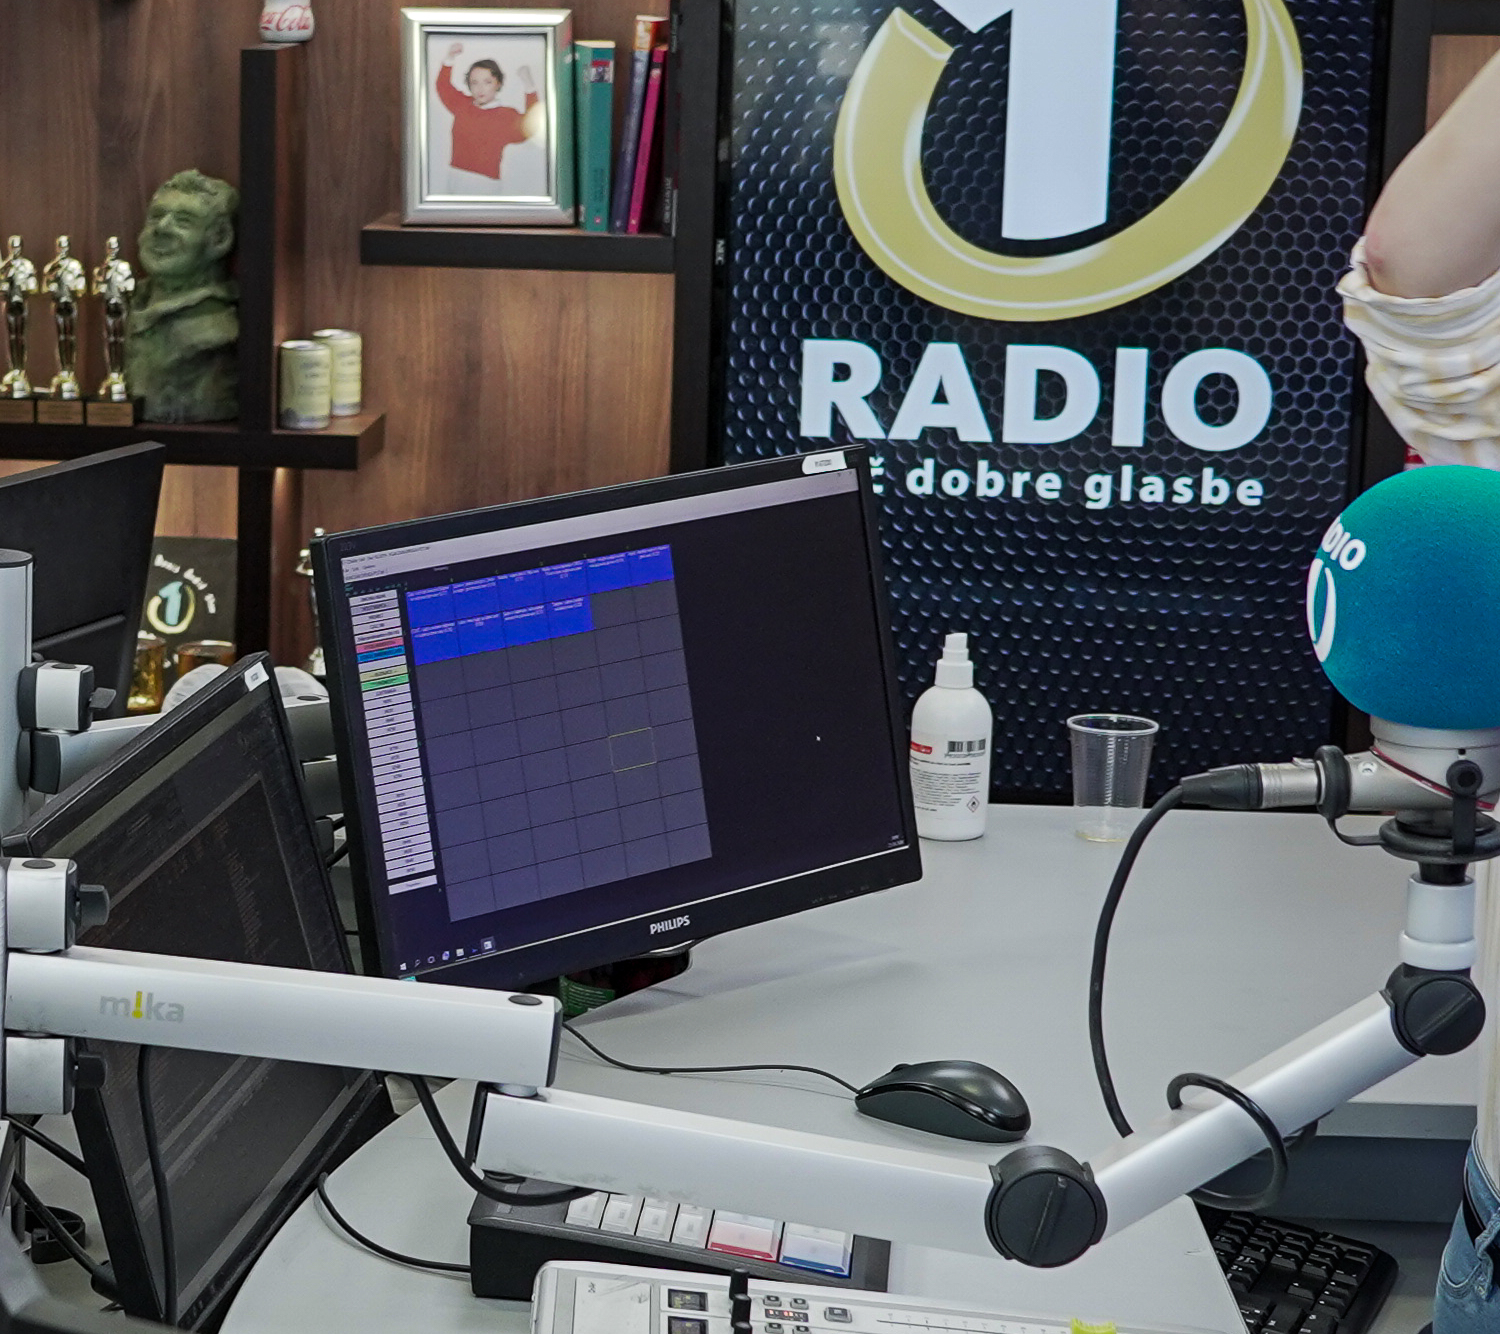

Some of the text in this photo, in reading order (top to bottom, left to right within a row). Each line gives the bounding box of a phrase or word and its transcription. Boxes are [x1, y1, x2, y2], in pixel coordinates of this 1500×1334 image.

[800, 337, 1273, 453] RADIO
[907, 457, 1061, 500] dobre
[1084, 465, 1264, 509] glasbe
[649, 915, 691, 935] PHILIPS
